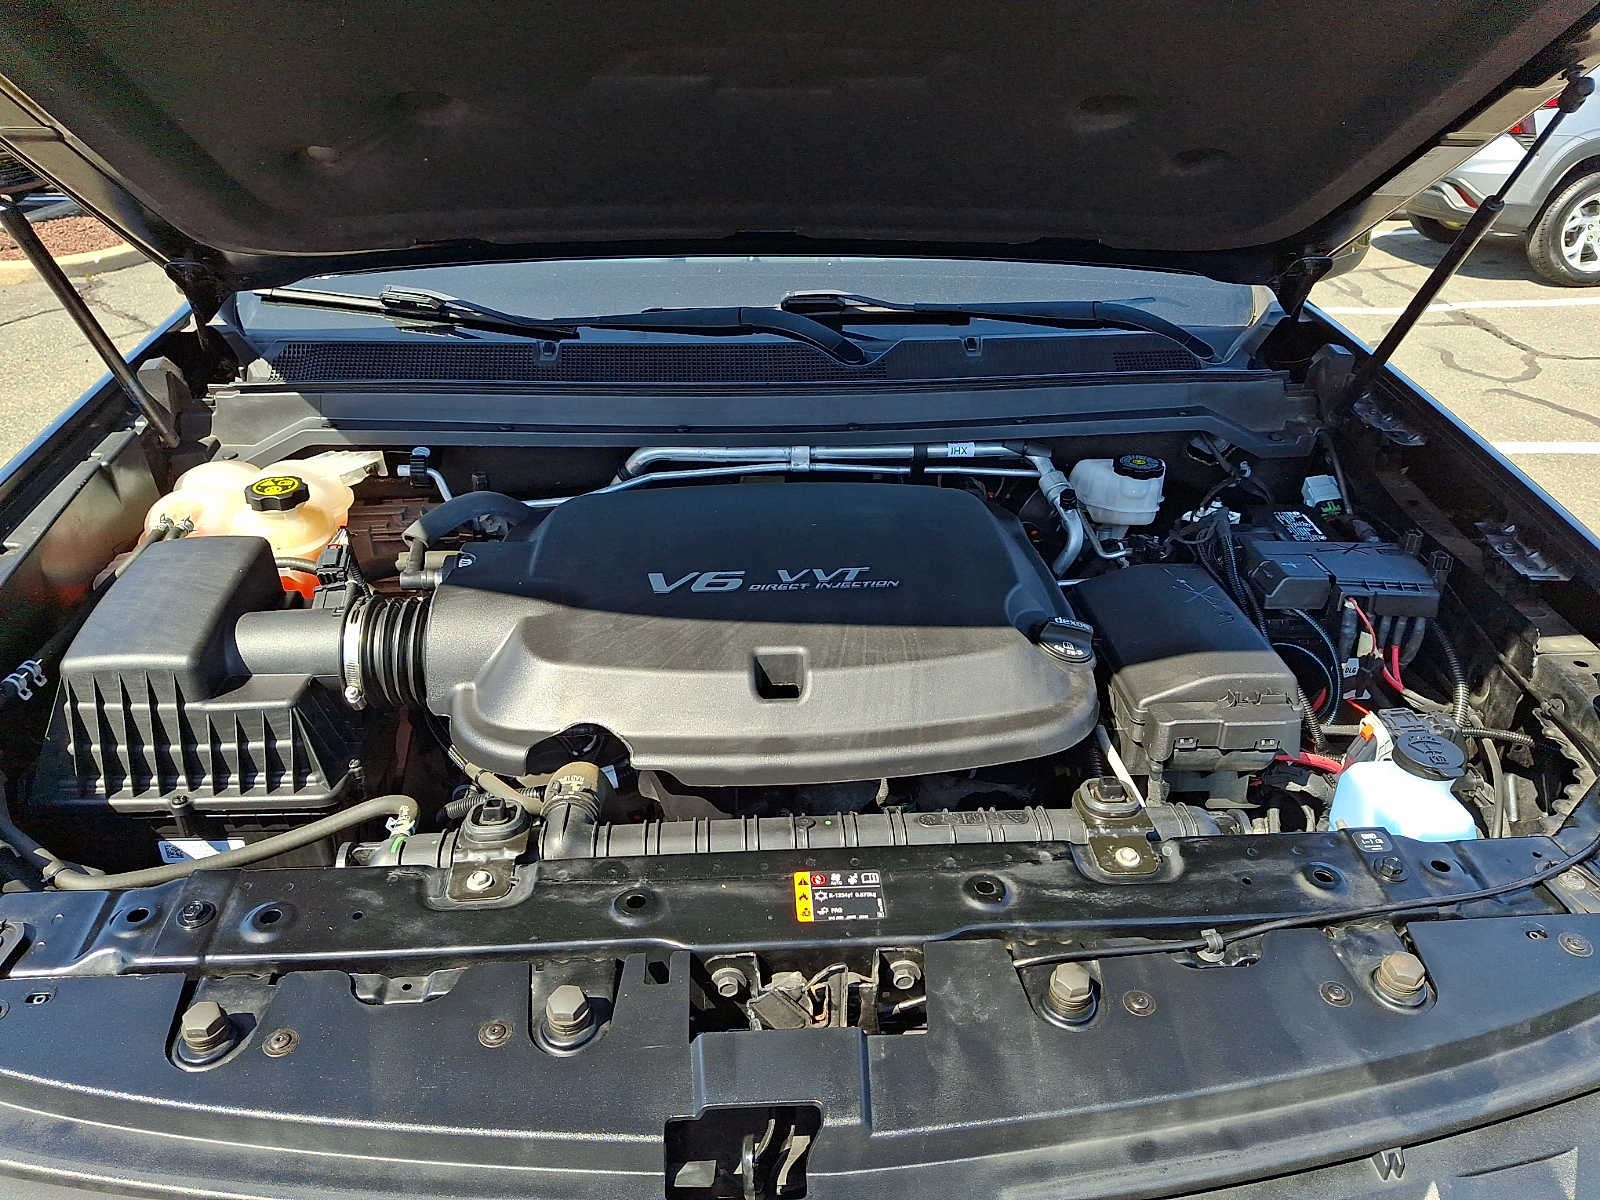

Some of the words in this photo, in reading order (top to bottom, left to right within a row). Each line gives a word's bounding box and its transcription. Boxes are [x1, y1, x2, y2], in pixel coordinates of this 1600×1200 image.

[647, 570, 746, 594] V6
[777, 566, 871, 582] VVT
[748, 583, 810, 592] DIRECT
[815, 580, 900, 590] INJECTION
